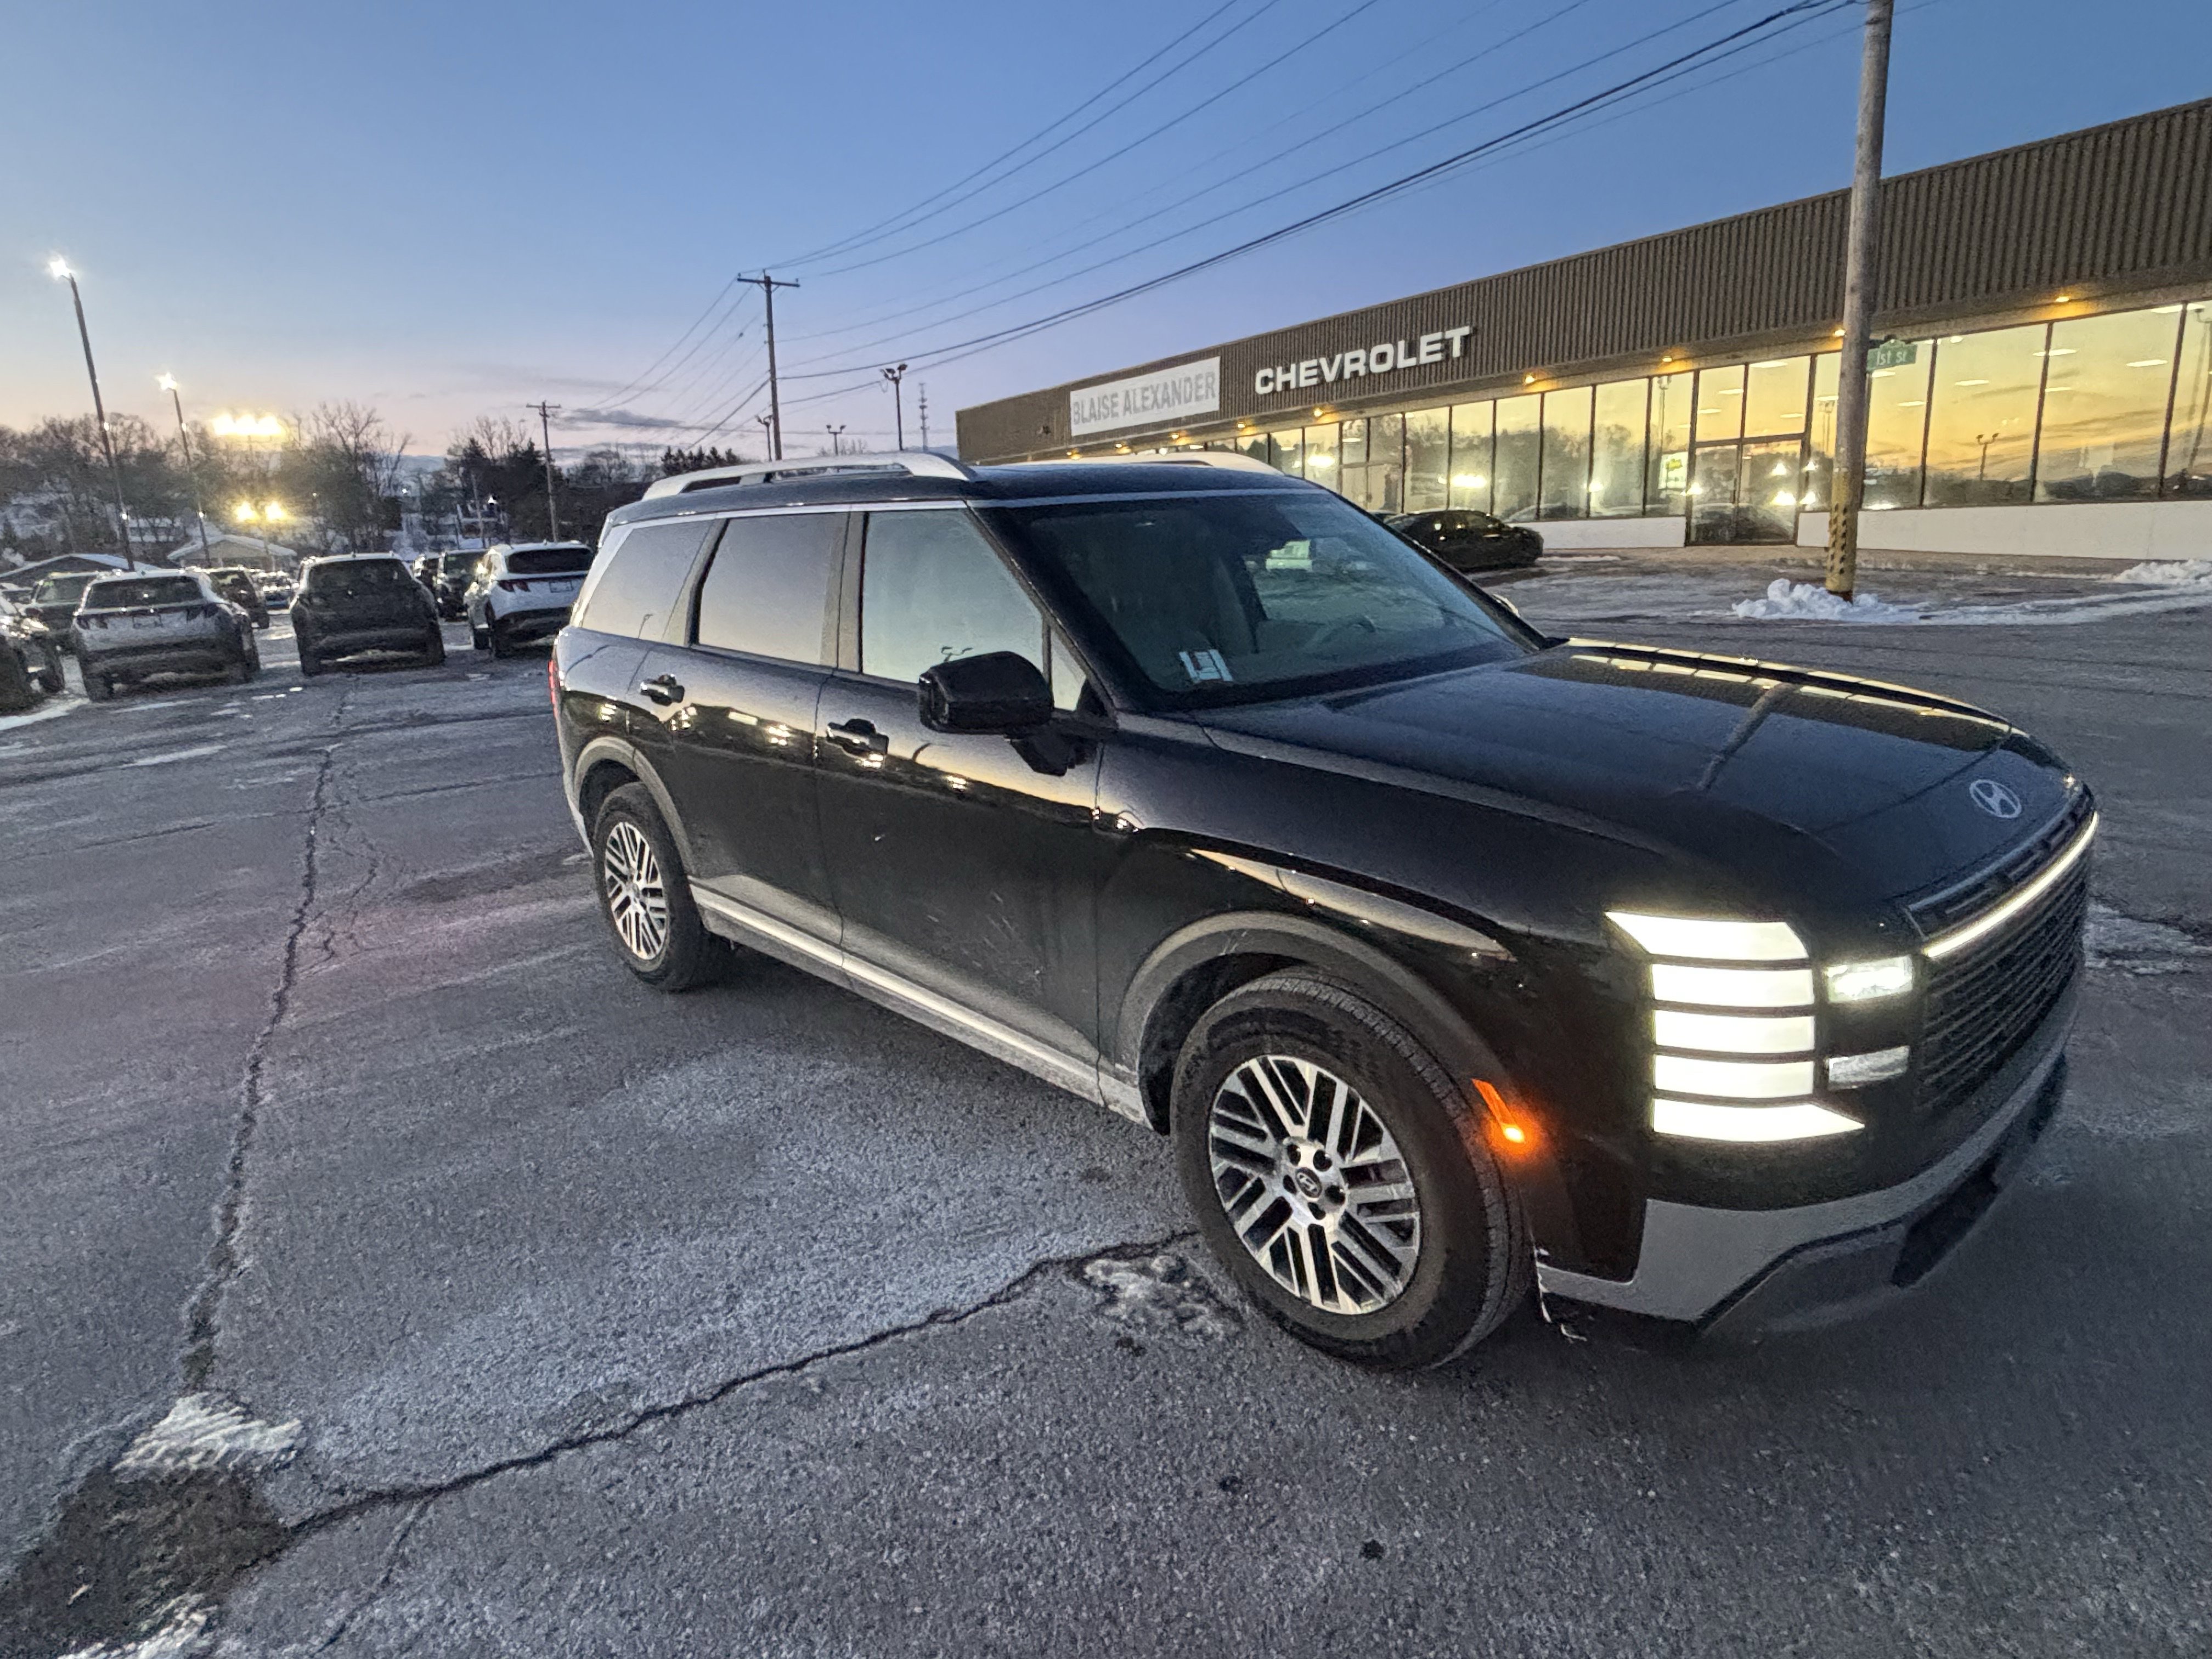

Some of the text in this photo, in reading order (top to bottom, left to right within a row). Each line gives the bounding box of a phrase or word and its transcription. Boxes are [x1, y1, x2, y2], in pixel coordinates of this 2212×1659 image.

[1255, 326, 1471, 394] CHEVROLET
[1876, 350, 1908, 366] 1st St
[1073, 371, 1216, 425] BLAISE ALEXANDER
